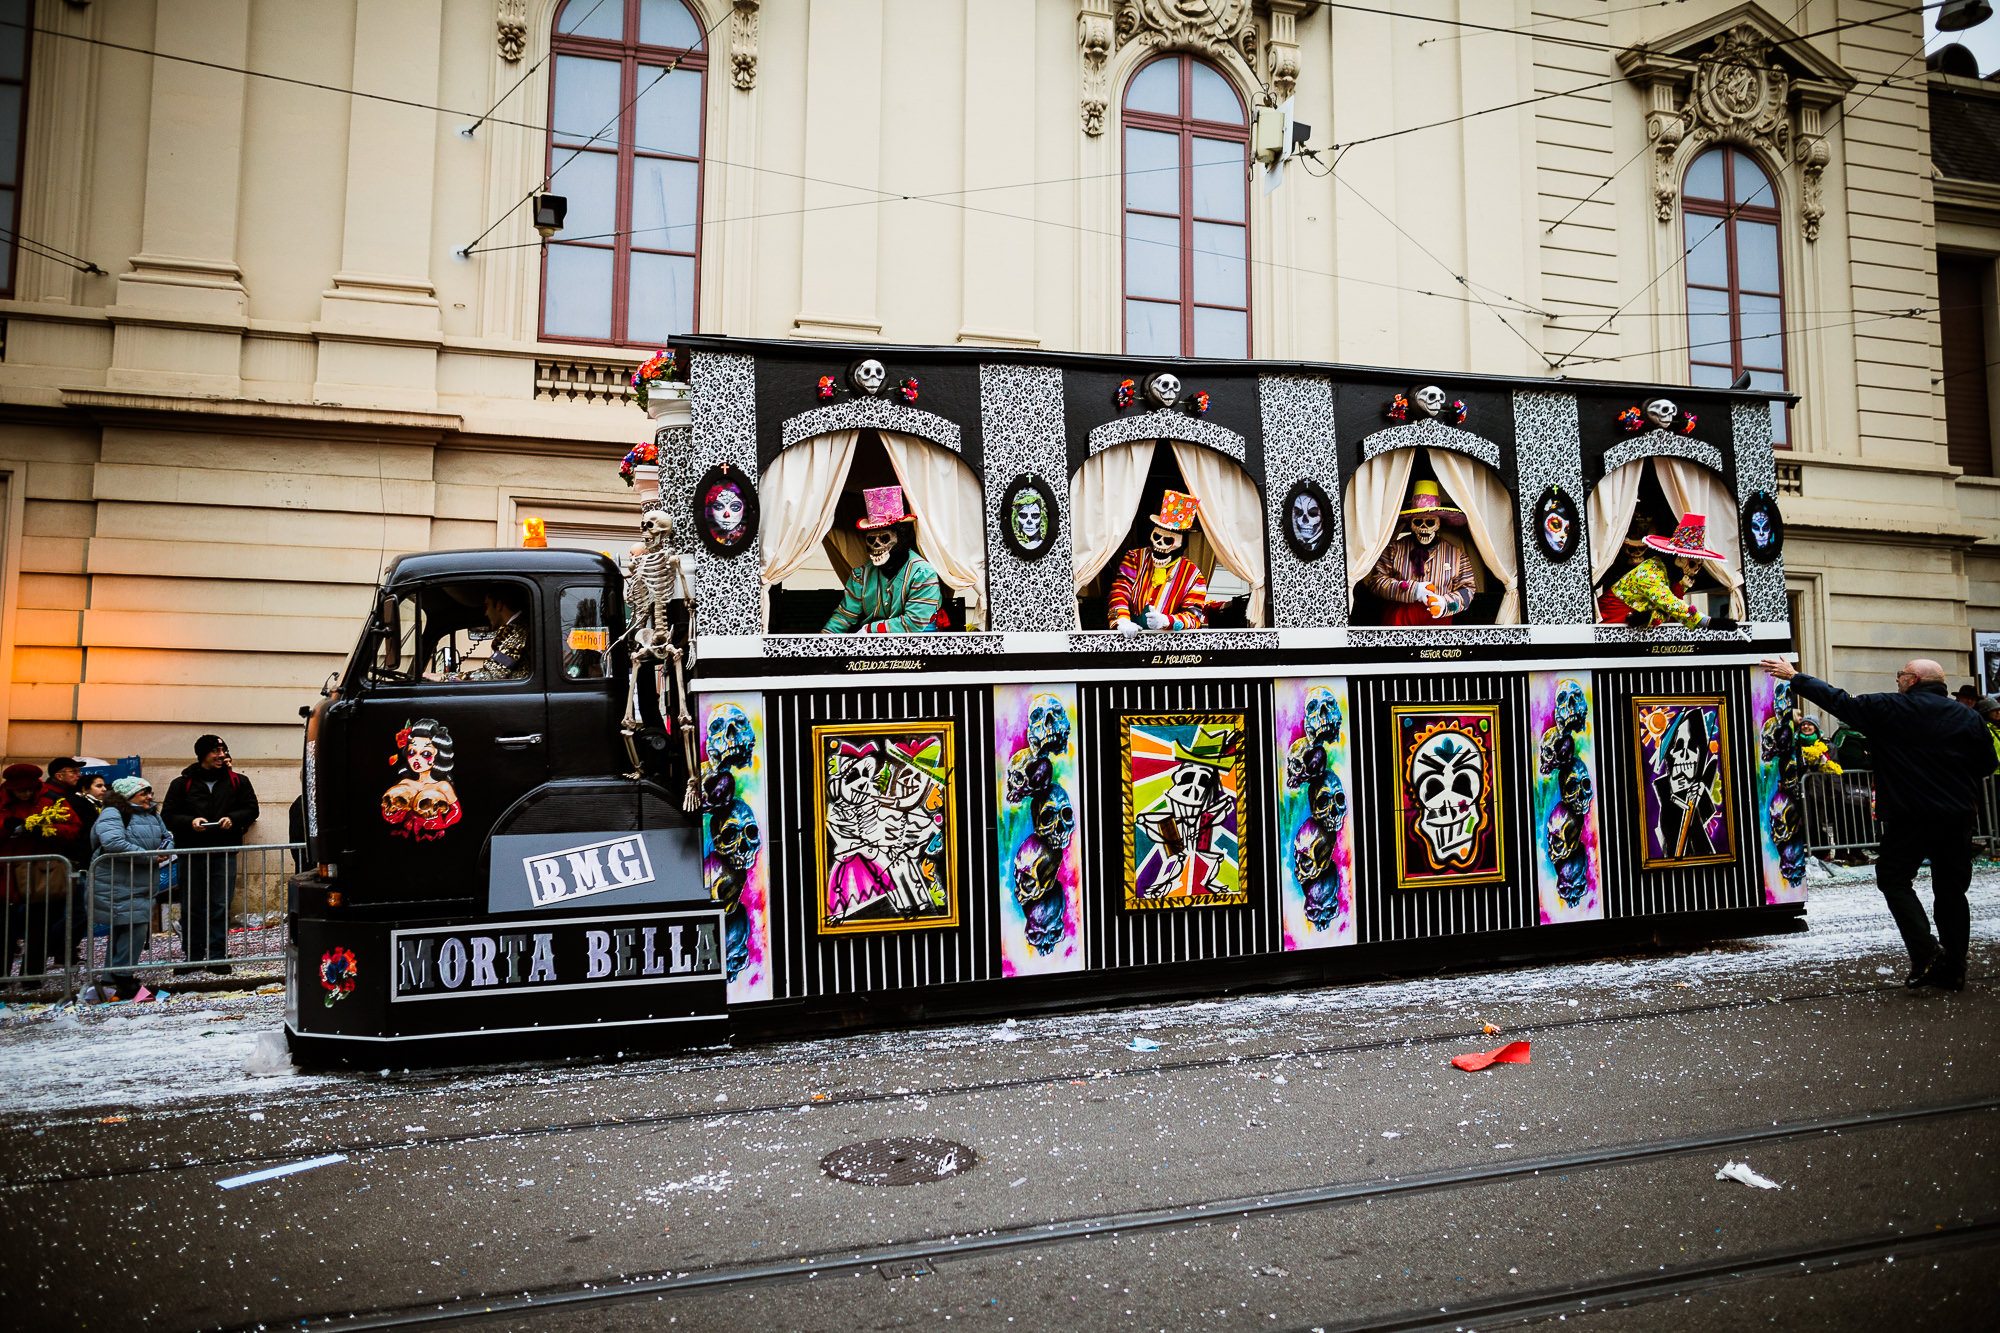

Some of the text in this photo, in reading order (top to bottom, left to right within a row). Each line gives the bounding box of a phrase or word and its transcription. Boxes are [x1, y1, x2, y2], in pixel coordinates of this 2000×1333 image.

[877, 660, 890, 670] DE
[1151, 655, 1163, 665] EL
[532, 839, 644, 902] BMG
[398, 922, 721, 991] MORTA BELLA
